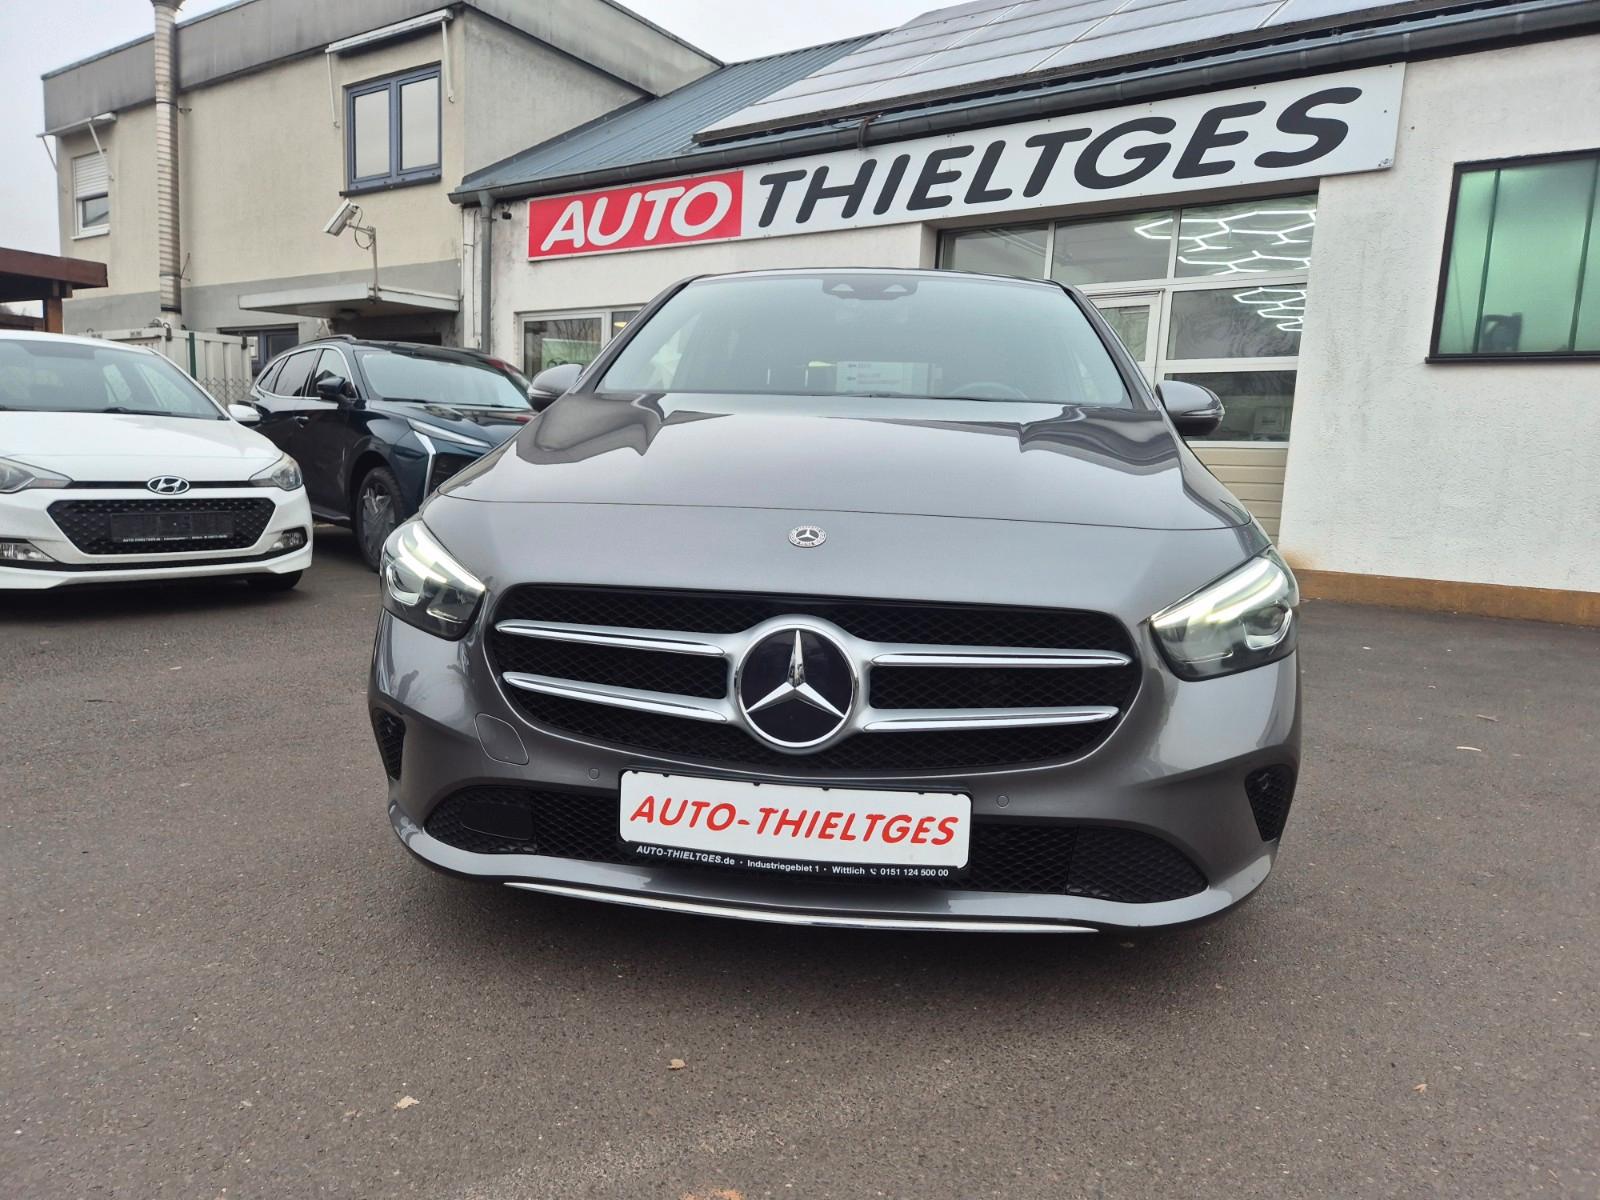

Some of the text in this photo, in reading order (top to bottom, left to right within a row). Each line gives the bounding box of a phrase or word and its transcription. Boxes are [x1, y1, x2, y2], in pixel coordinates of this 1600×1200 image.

[540, 86, 1363, 252] AUTO THIELTGES
[630, 795, 959, 846] AUTO-THIELTGES
[636, 845, 949, 877] AUTO-THIELTGES.de Industriegebiet 1 Wittlich 0151 124 500 00
